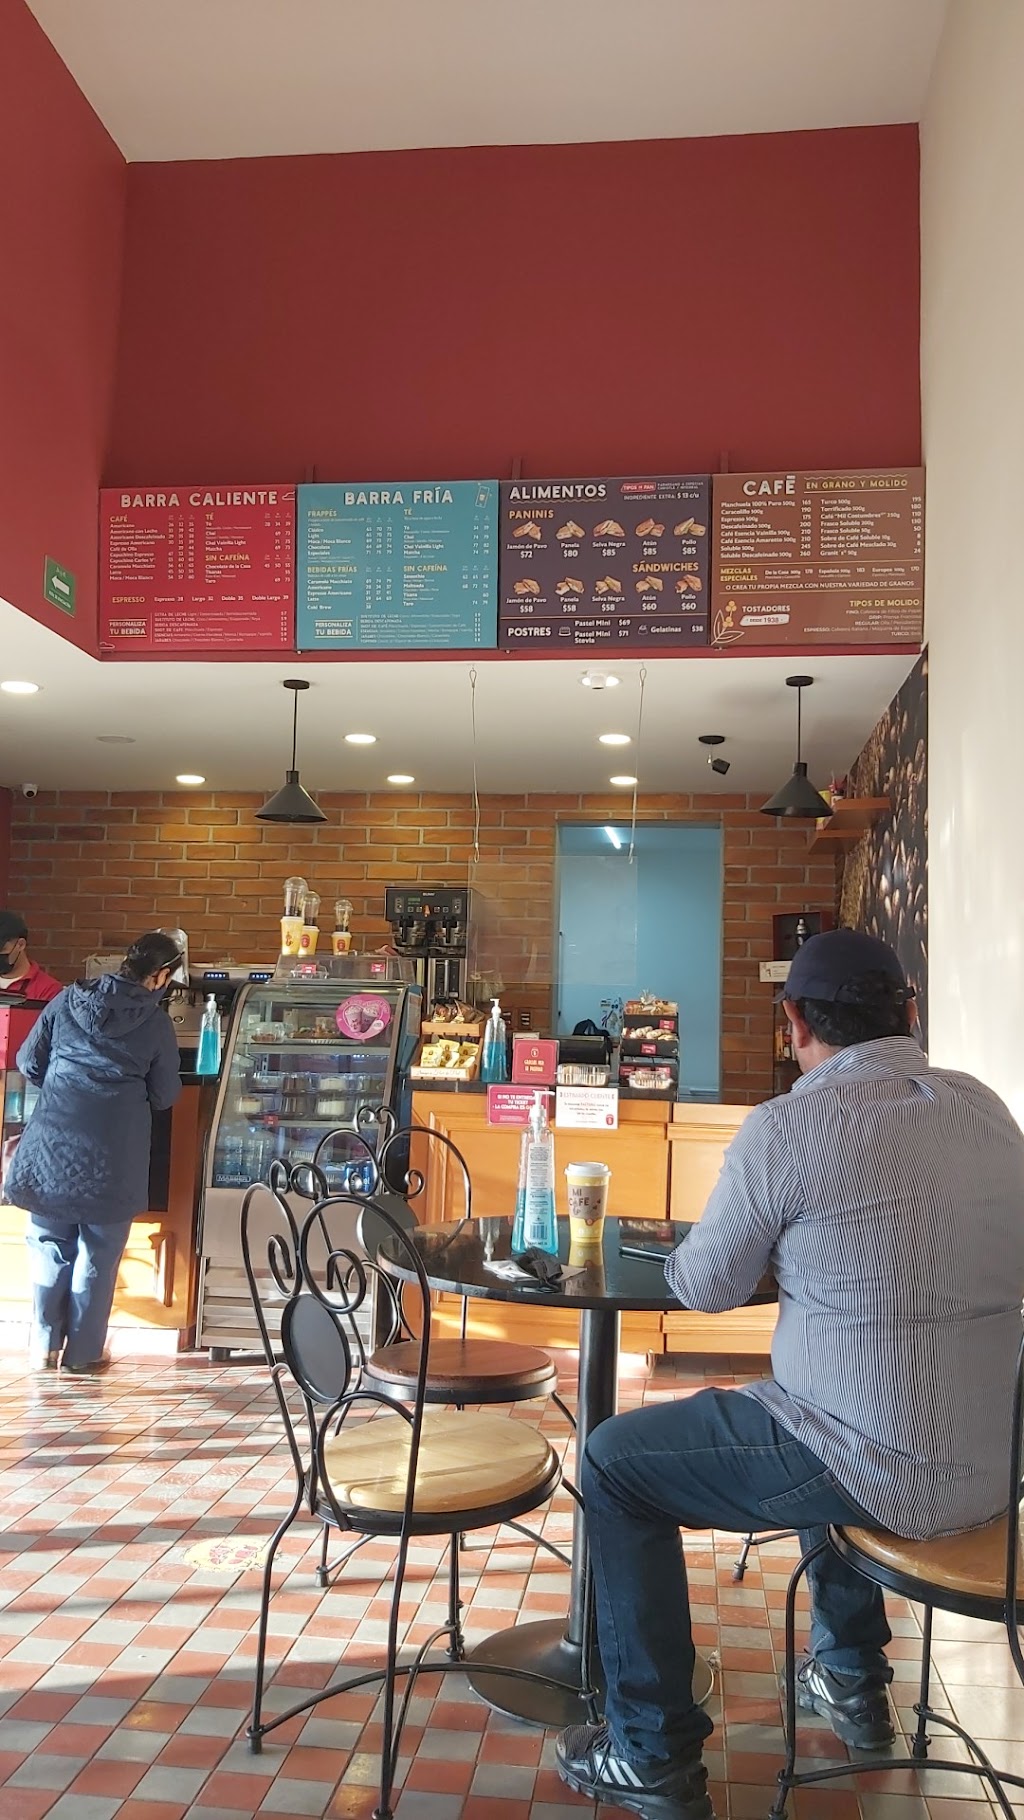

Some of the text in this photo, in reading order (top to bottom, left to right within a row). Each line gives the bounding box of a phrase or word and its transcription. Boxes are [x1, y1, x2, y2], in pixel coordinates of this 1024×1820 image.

[742, 475, 796, 496] CAFÉ
[805, 479, 908, 490] EN GRANO Y MOLIDO
[344, 486, 453, 505] BARRA FRÍA
[509, 484, 607, 500] ALIMENTOS
[121, 491, 277, 508] BARRA CALIENTE
[307, 509, 337, 517] FRAPPÉS
[403, 508, 412, 516] TÉ
[509, 509, 555, 520] PANINIS
[109, 514, 128, 523] CAFÉ
[205, 513, 214, 521] TÉ
[506, 542, 524, 550] Jamón
[607, 541, 626, 549] Negra
[520, 550, 533, 559] $72
[563, 549, 579, 558] $80
[601, 548, 616, 557] $85
[642, 547, 658, 556] $85
[682, 547, 697, 556] $85
[219, 553, 250, 561] CAFEÍNA
[307, 565, 358, 574] BEBIDAS FRÍAS
[416, 563, 448, 572] CAFEÍNA
[632, 560, 699, 573] SÁNDWICHES
[720, 567, 752, 575] MEZCLAS
[720, 574, 758, 582] ESPECIALES
[756, 583, 780, 591] PROPIA
[779, 582, 804, 590] MEZCLA
[803, 582, 820, 590] CON
[819, 581, 848, 589] NUESTRA
[847, 580, 879, 588] VARIEDAD
[879, 580, 888, 588] DE
[887, 579, 915, 588] GRANOS
[112, 596, 146, 604] ESPRESSO
[848, 598, 920, 608] TIPOS DE MOLIDO
[519, 605, 534, 613] $58
[562, 604, 577, 613] $58
[601, 603, 616, 612] $58
[642, 602, 658, 611] $60
[681, 602, 697, 611] $60
[741, 604, 791, 613] TOSTADORES
[618, 619, 631, 627] $69
[763, 616, 780, 624] 1938
[507, 627, 552, 637] POSTRES
[691, 625, 704, 633] $38
[572, 1188, 582, 1197] MI
